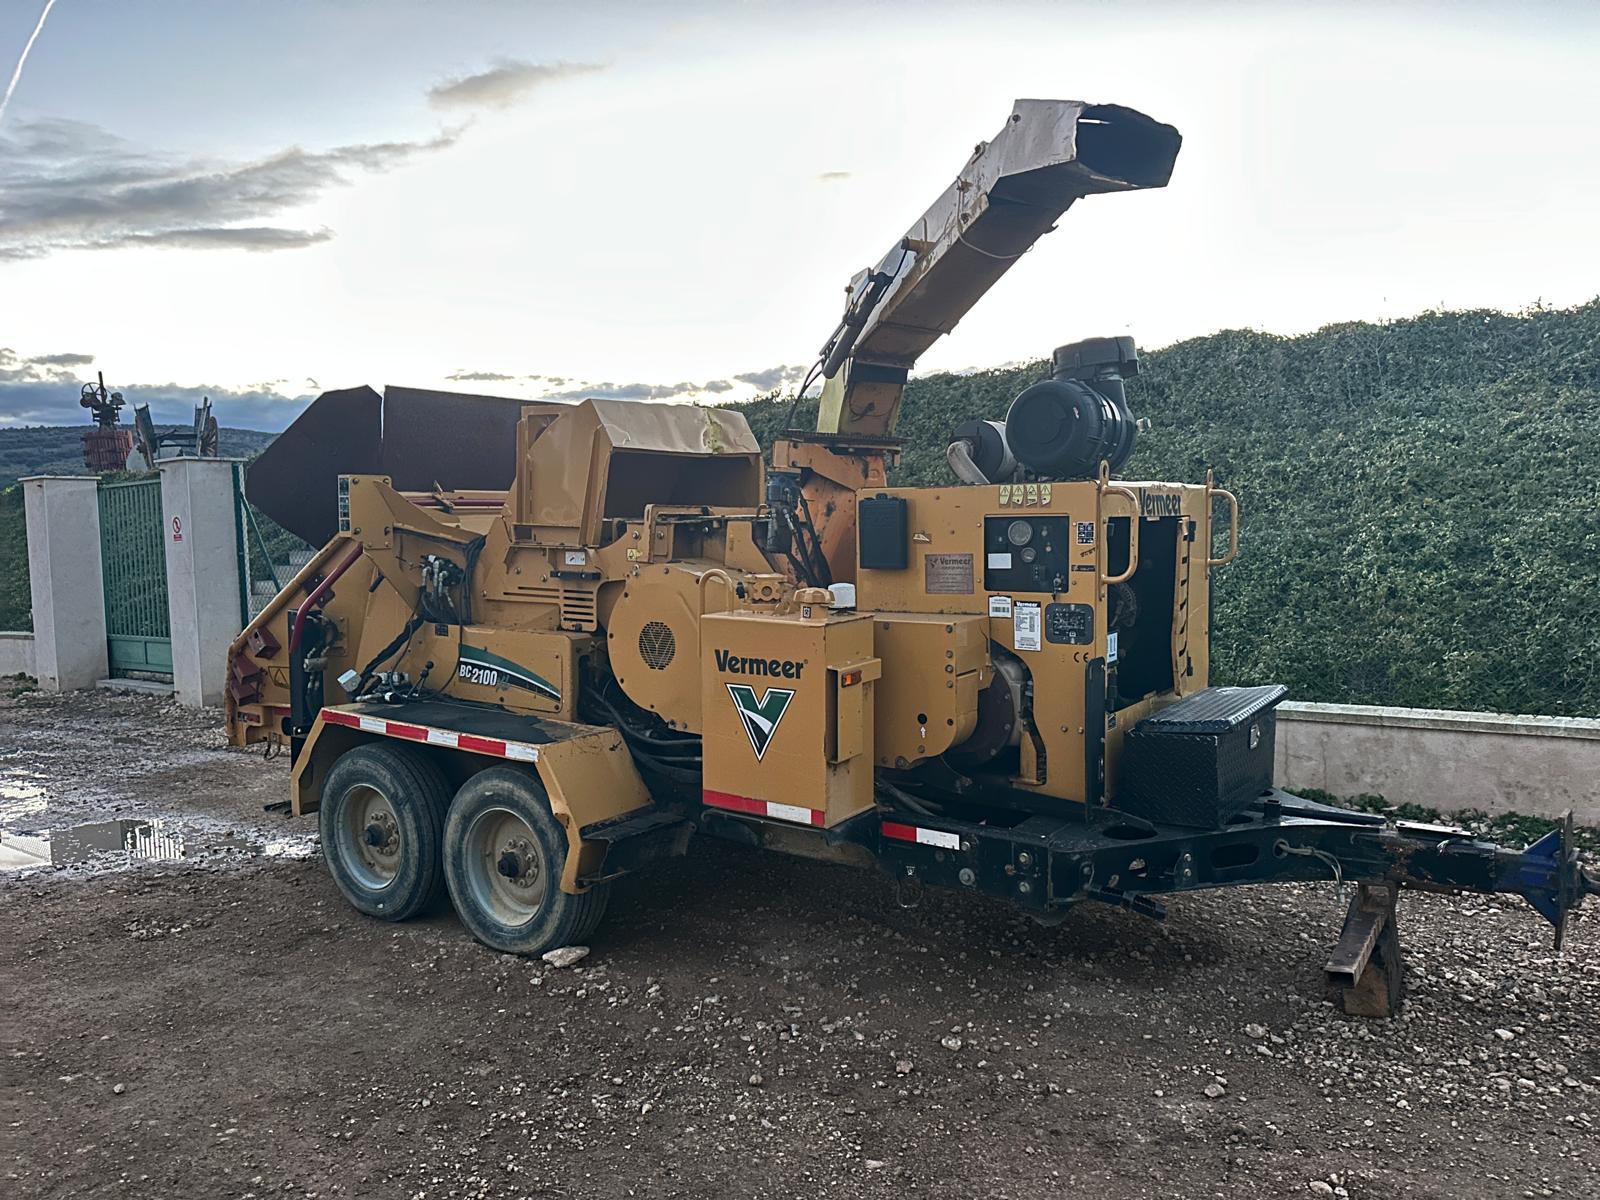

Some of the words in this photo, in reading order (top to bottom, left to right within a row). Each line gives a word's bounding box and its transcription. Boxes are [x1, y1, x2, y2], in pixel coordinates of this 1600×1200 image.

[1138, 486, 1182, 516] Vermeer
[939, 557, 971, 565] Vermeer
[714, 648, 805, 680] Vermeer
[1073, 651, 1089, 663] CE
